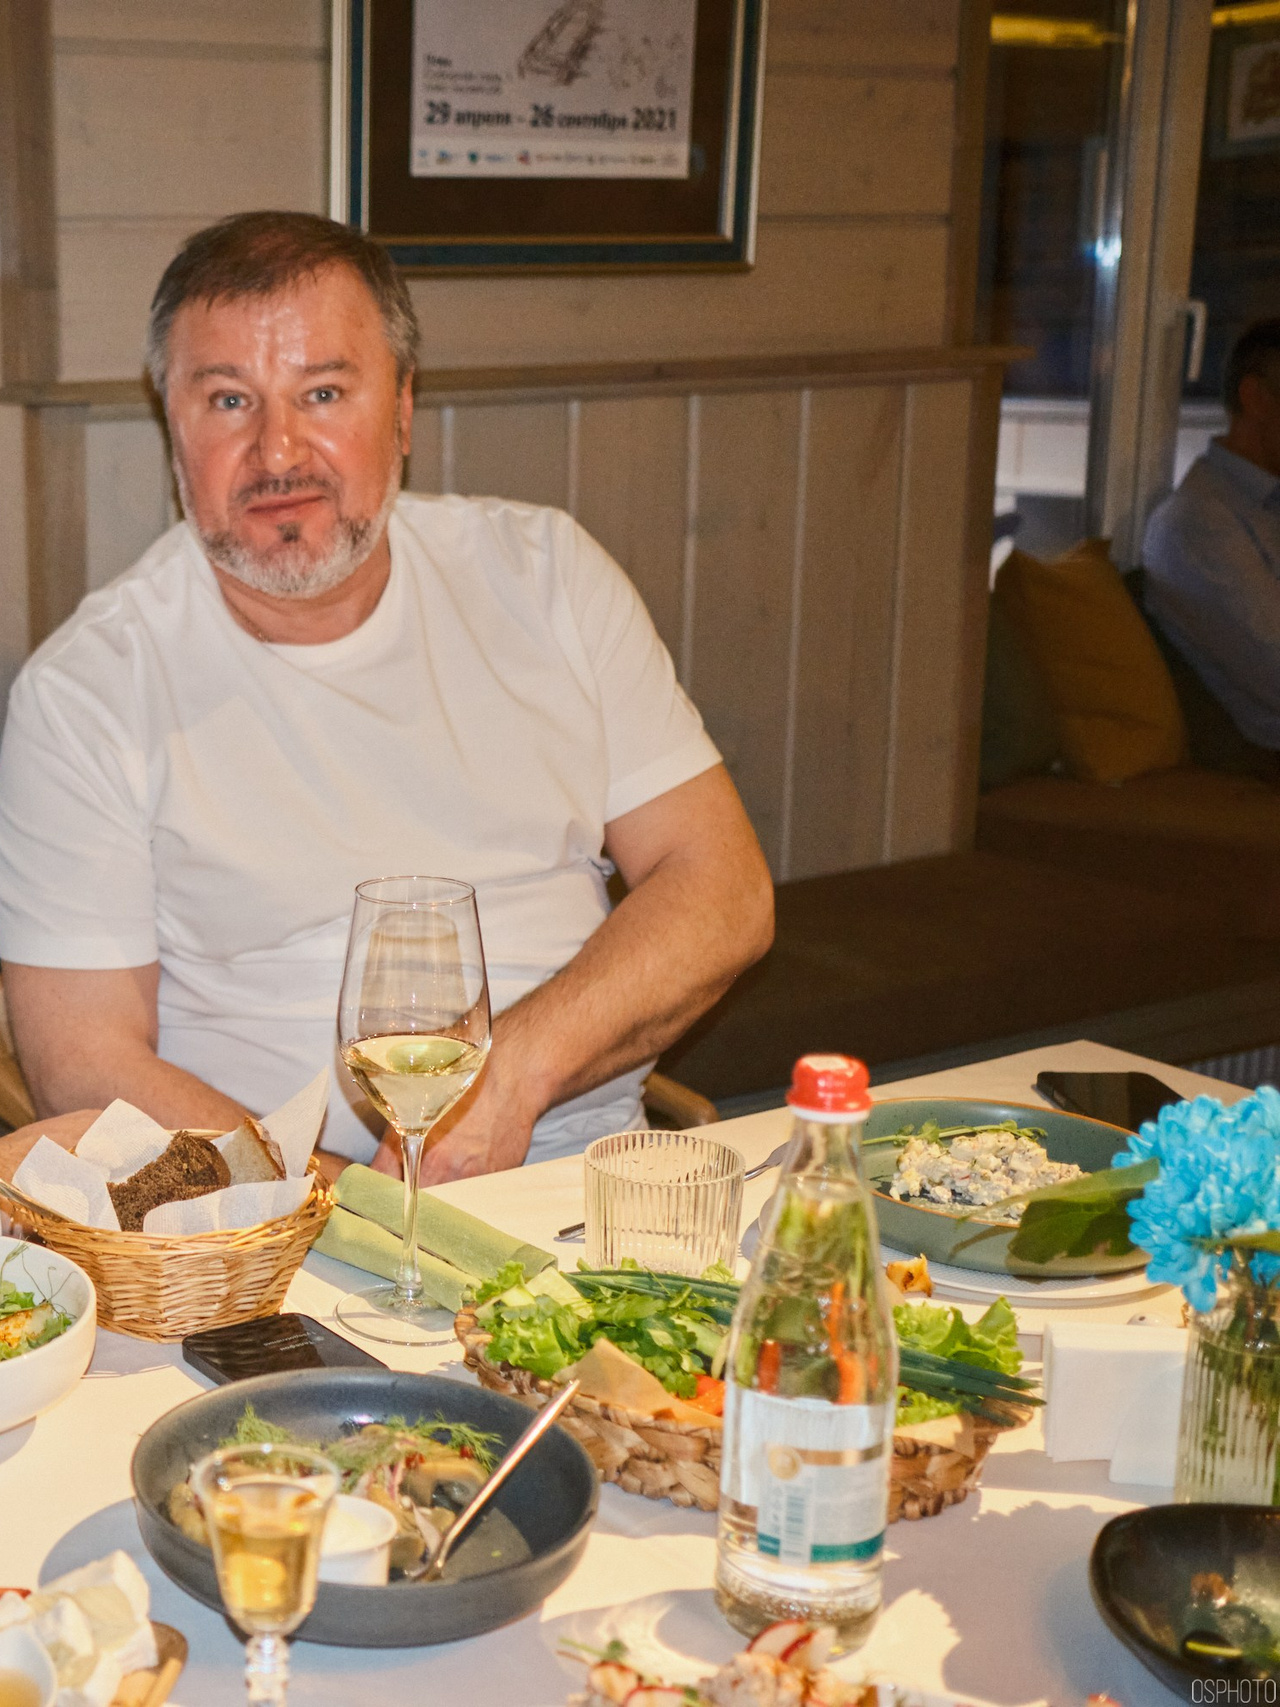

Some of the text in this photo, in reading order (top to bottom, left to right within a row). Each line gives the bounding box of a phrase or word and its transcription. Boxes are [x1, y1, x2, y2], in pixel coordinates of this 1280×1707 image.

[426, 101, 450, 125] 29
[531, 103, 554, 129] 26
[632, 106, 677, 131] 2021
